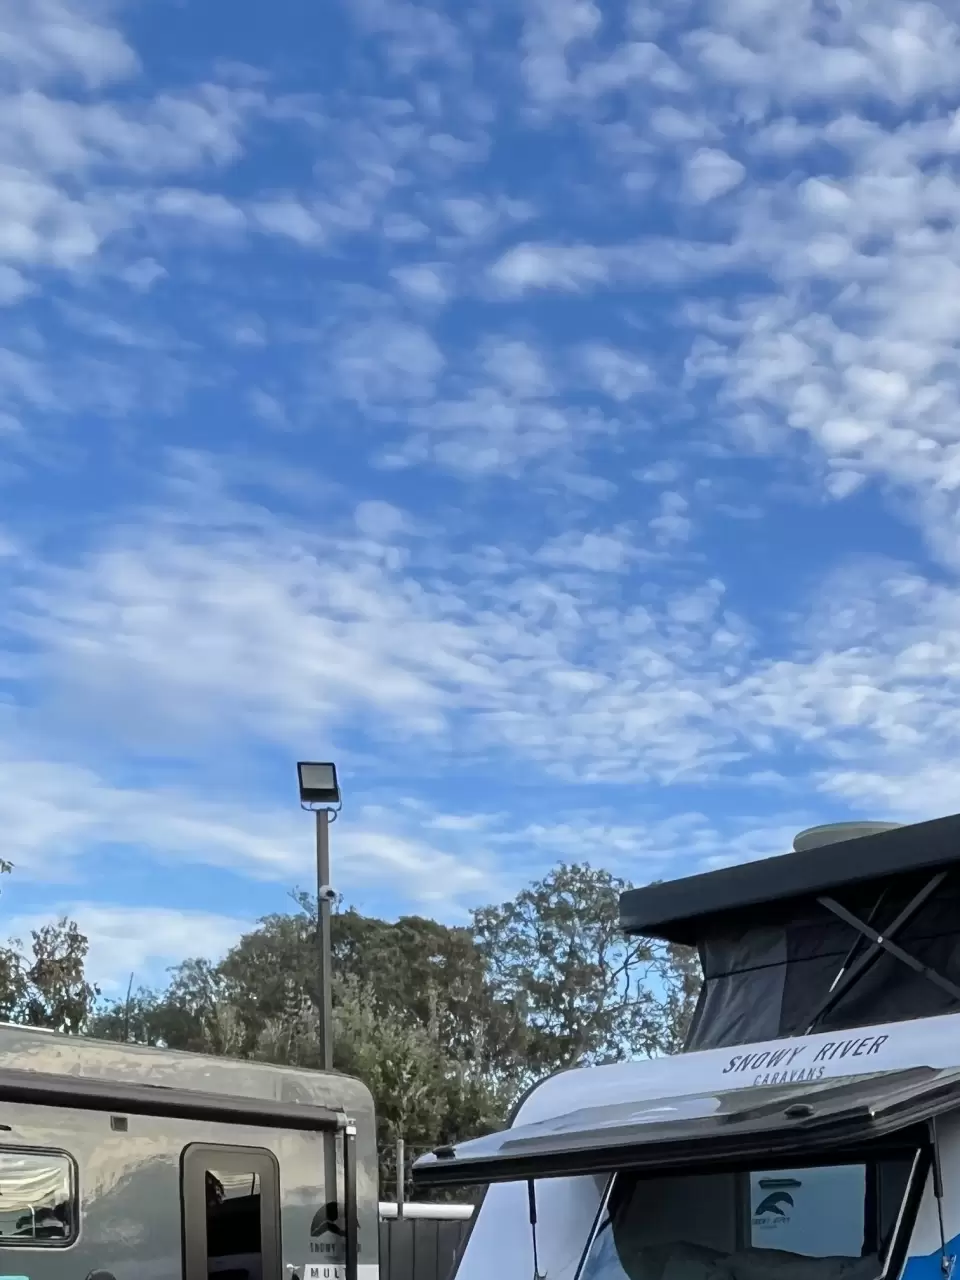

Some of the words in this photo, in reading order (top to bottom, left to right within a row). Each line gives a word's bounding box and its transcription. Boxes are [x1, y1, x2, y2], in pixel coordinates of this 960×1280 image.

[722, 1045, 807, 1074] SNOWY
[813, 1034, 889, 1063] RIVER
[753, 1066, 826, 1086] CARAVANS
